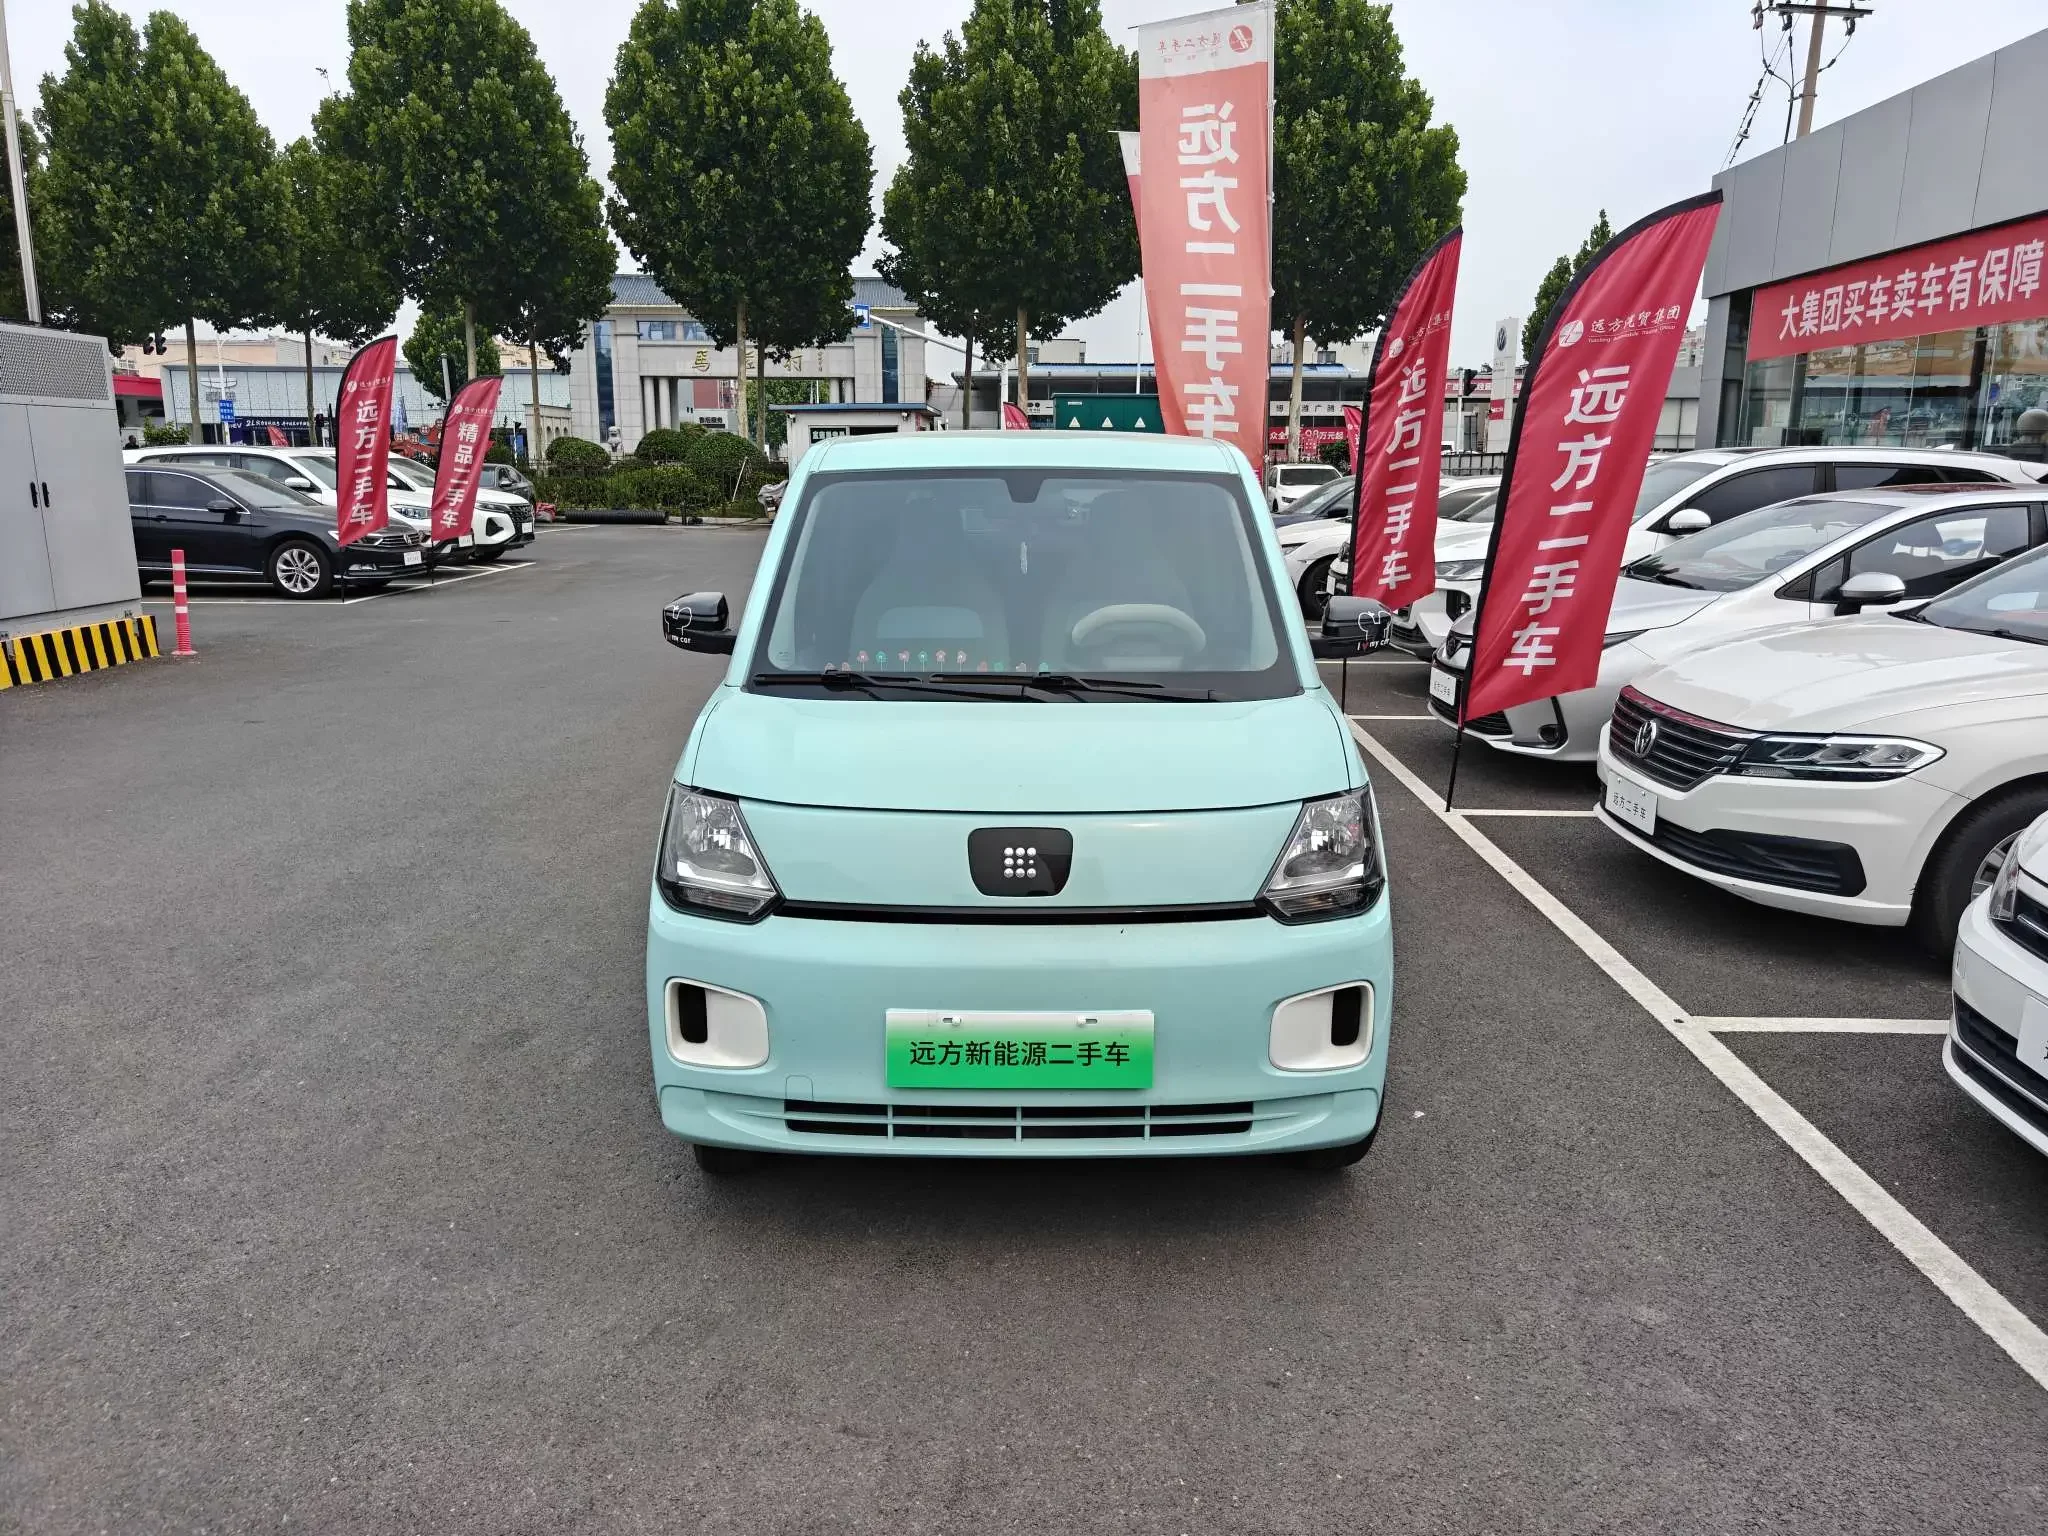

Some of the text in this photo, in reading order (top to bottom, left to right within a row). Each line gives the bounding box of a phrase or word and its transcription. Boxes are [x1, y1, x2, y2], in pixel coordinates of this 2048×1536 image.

[1778, 238, 2046, 341] 大集团买车卖车有保障
[350, 400, 379, 525] 远方二手车
[440, 421, 479, 528] 精品二手车
[1378, 358, 1426, 589] 远方二手车
[1502, 365, 1630, 676] 远方二手车
[909, 1040, 1130, 1067] 远方新能源二手车
